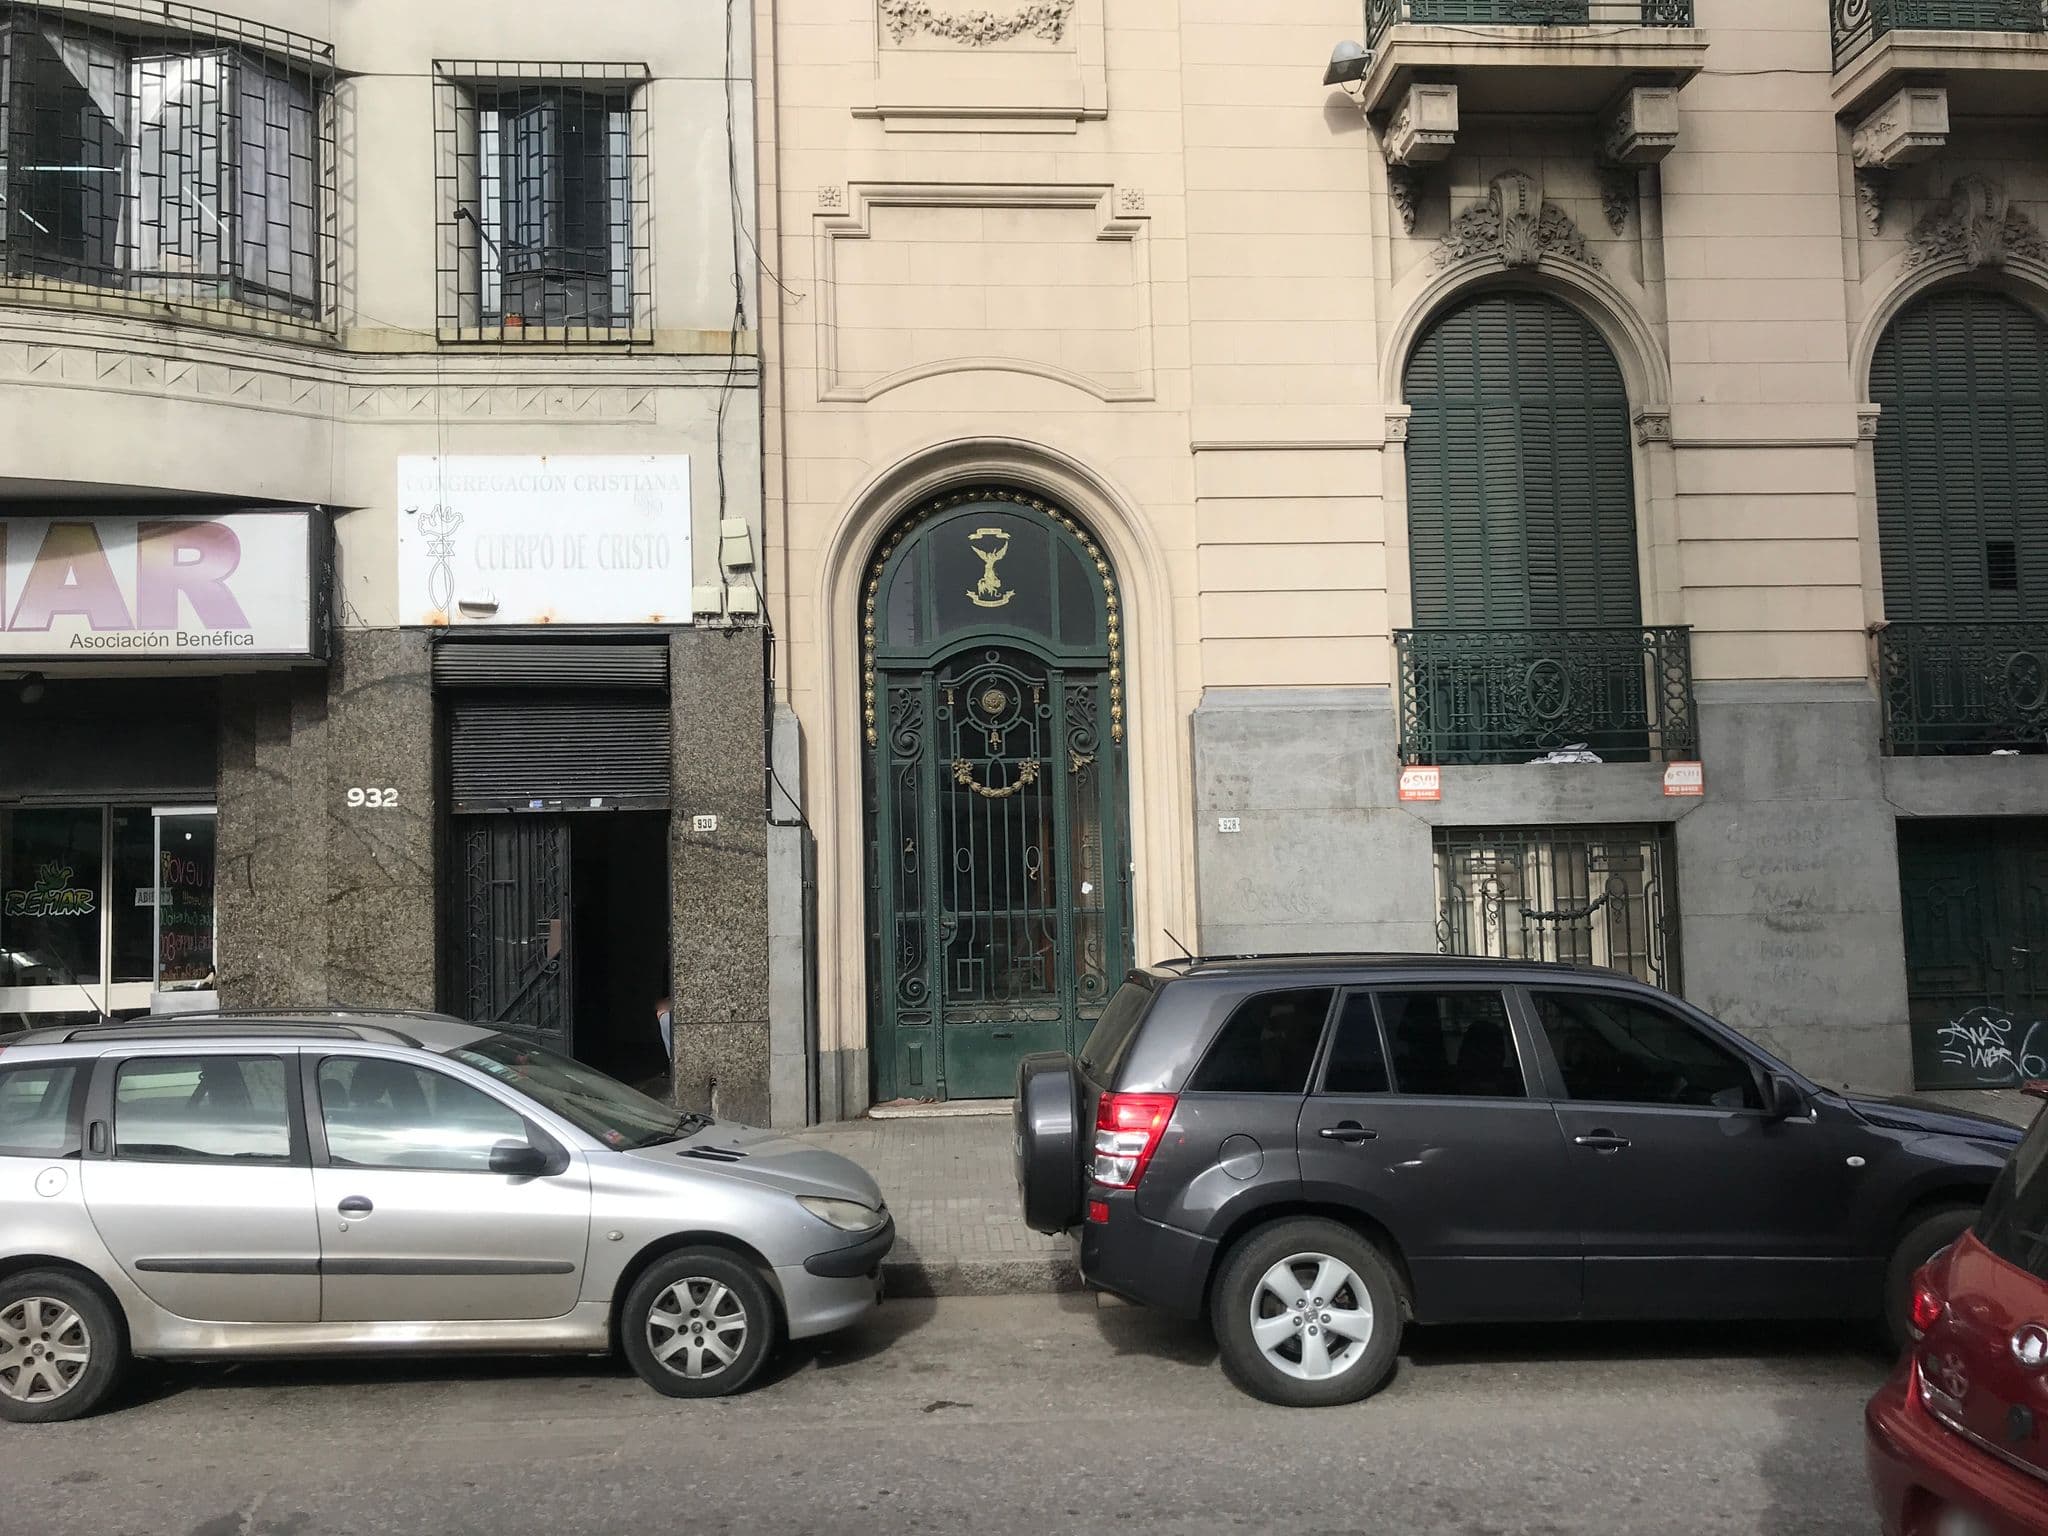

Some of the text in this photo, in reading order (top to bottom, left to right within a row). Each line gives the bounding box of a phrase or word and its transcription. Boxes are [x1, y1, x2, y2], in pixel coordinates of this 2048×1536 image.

[573, 473, 681, 492] CRISTIANA
[474, 532, 671, 571] CUERPO DE CRISTO
[0, 520, 252, 632] AR
[70, 631, 255, 649] Asociación Benéfica
[347, 787, 398, 807] 932
[697, 818, 712, 829] 930
[5, 888, 96, 917] REMAR
